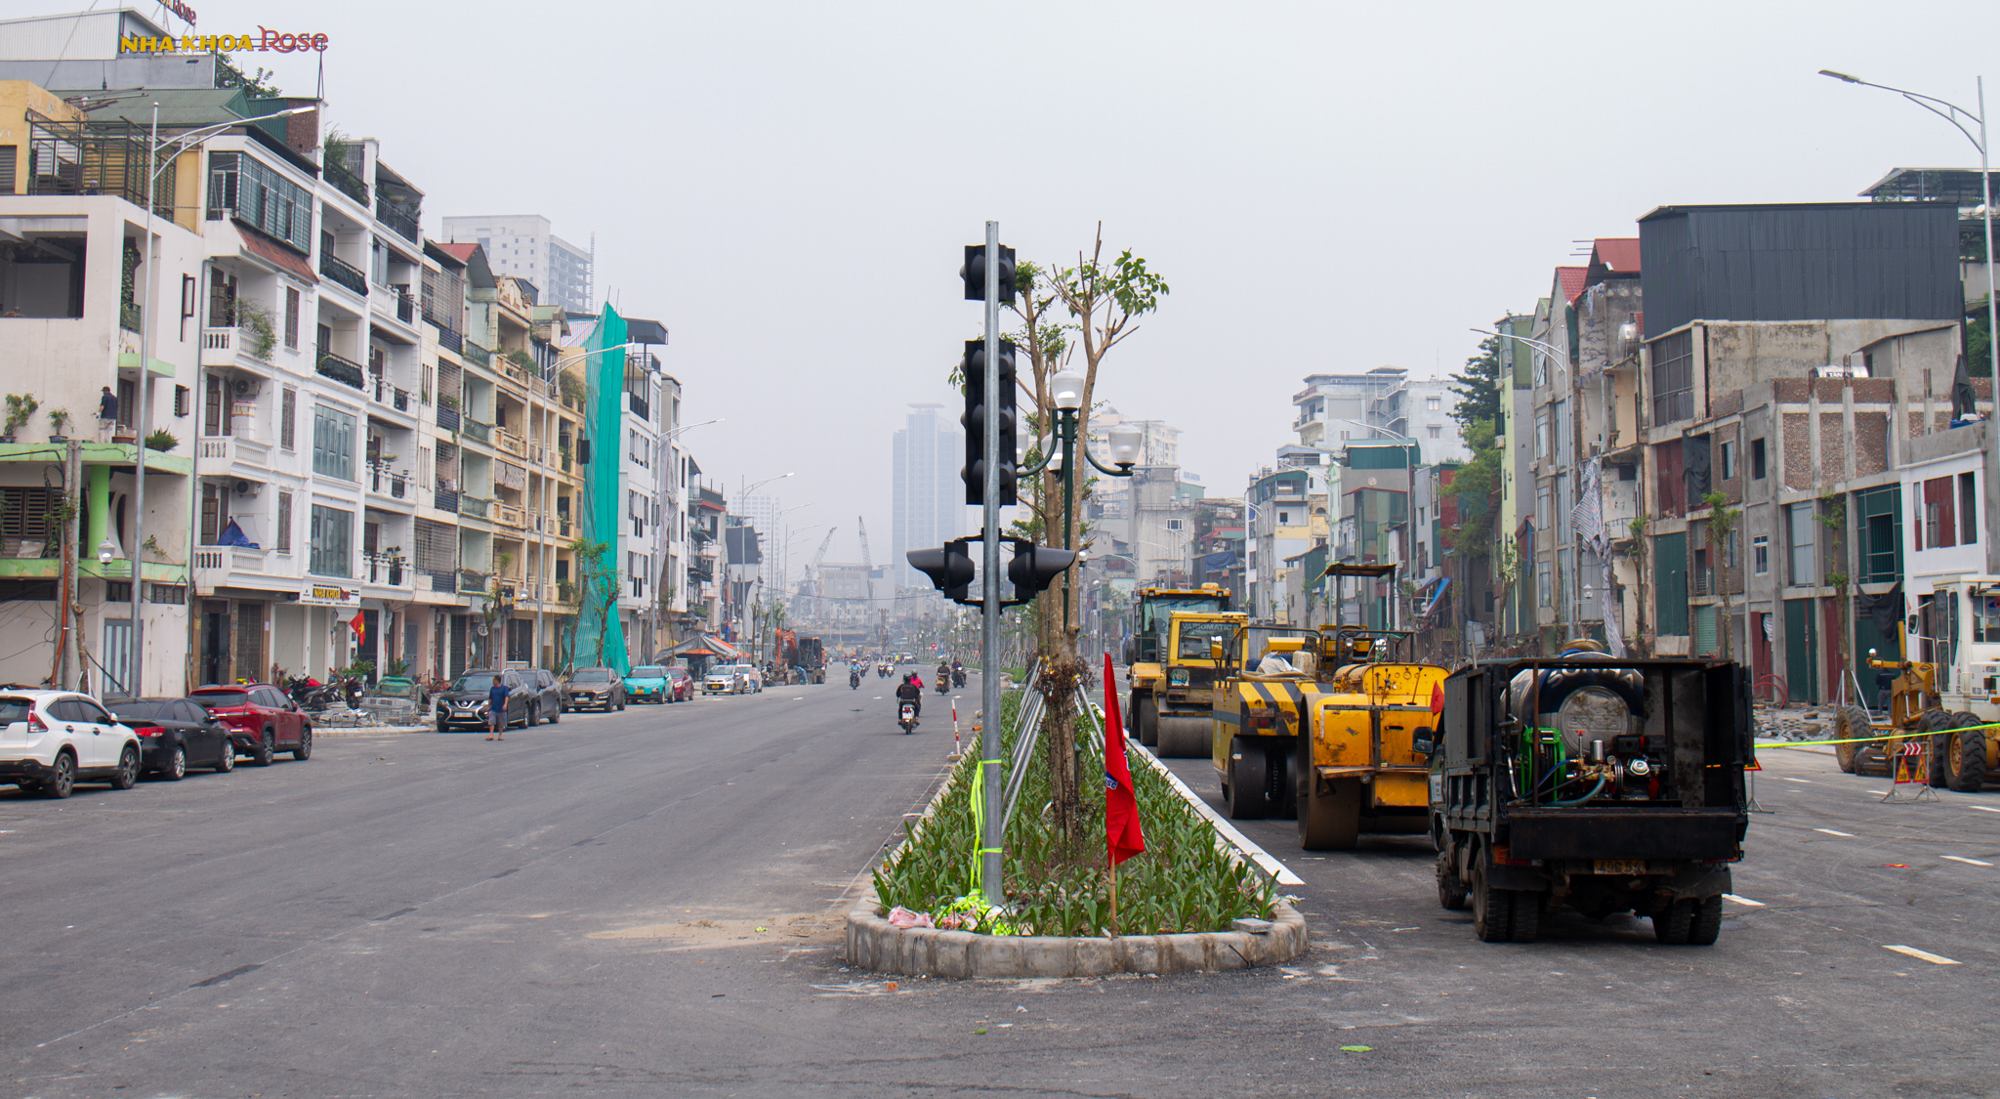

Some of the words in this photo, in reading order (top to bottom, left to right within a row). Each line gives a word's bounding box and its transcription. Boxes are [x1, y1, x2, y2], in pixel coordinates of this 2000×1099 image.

[120, 36, 175, 53] NHA
[181, 34, 254, 52] KHOA
[257, 25, 329, 54] Rose
[312, 587, 325, 599] NHA
